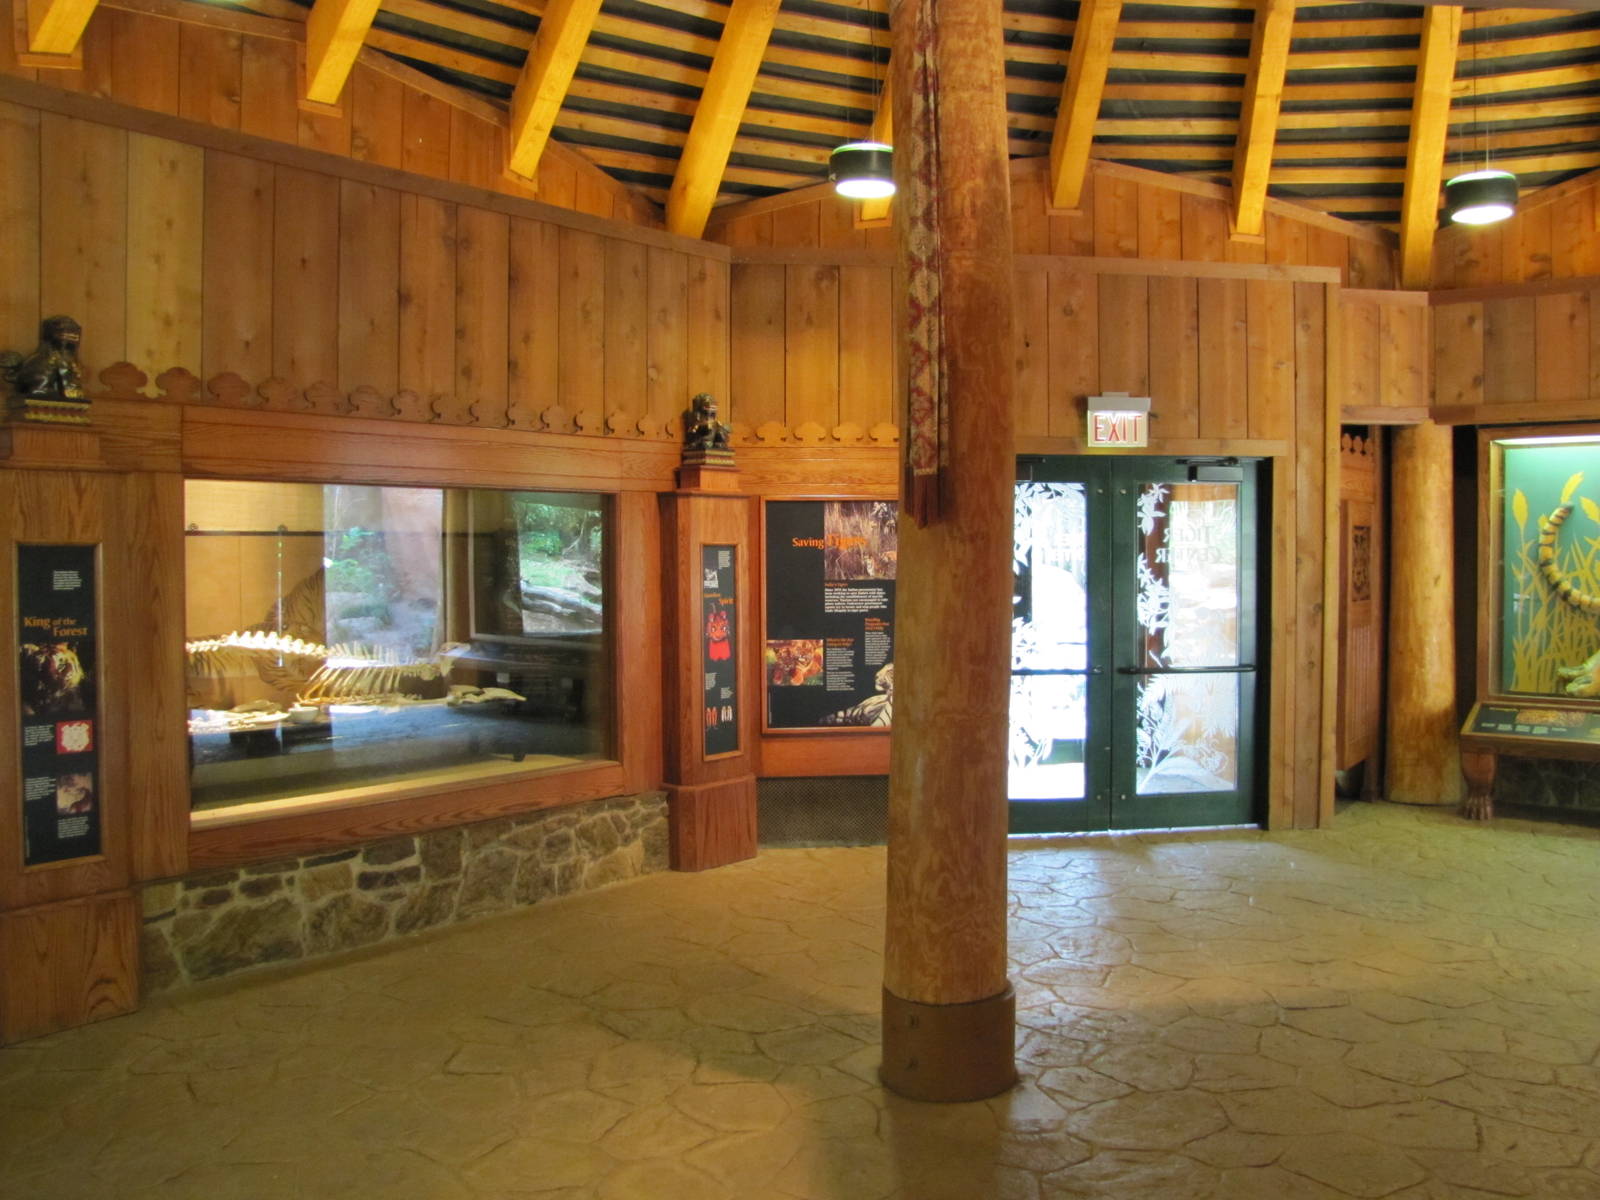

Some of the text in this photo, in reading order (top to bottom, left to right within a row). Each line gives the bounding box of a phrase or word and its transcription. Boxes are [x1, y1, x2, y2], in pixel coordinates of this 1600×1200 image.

[1093, 414, 1143, 442] EXIT
[792, 536, 825, 550] Saving
[24, 616, 51, 630] King
[53, 626, 88, 637] Forest
